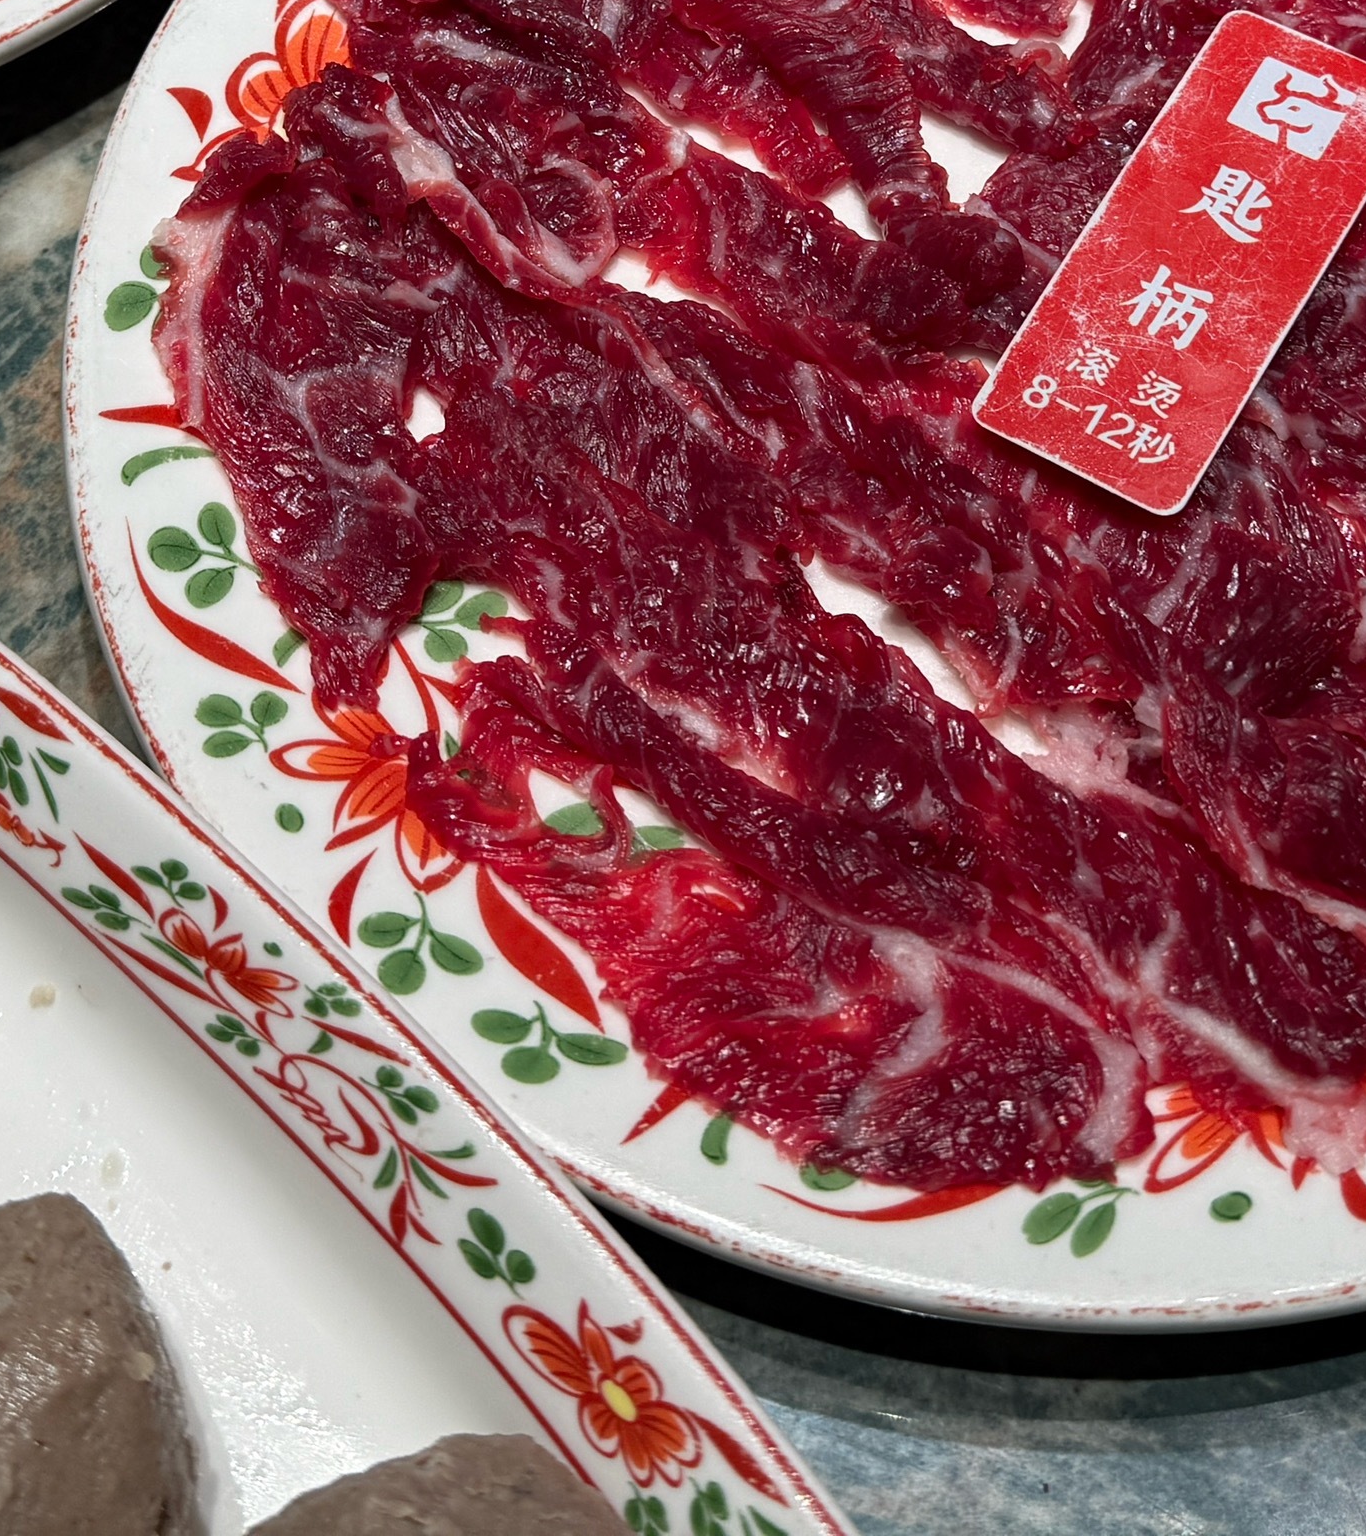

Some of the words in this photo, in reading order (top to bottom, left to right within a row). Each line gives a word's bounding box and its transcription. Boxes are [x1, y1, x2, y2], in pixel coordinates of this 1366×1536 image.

[1120, 164, 1273, 351] 匙柄
[1022, 374, 1176, 465] 8-12秒
[1065, 341, 1184, 419] 滚烫
